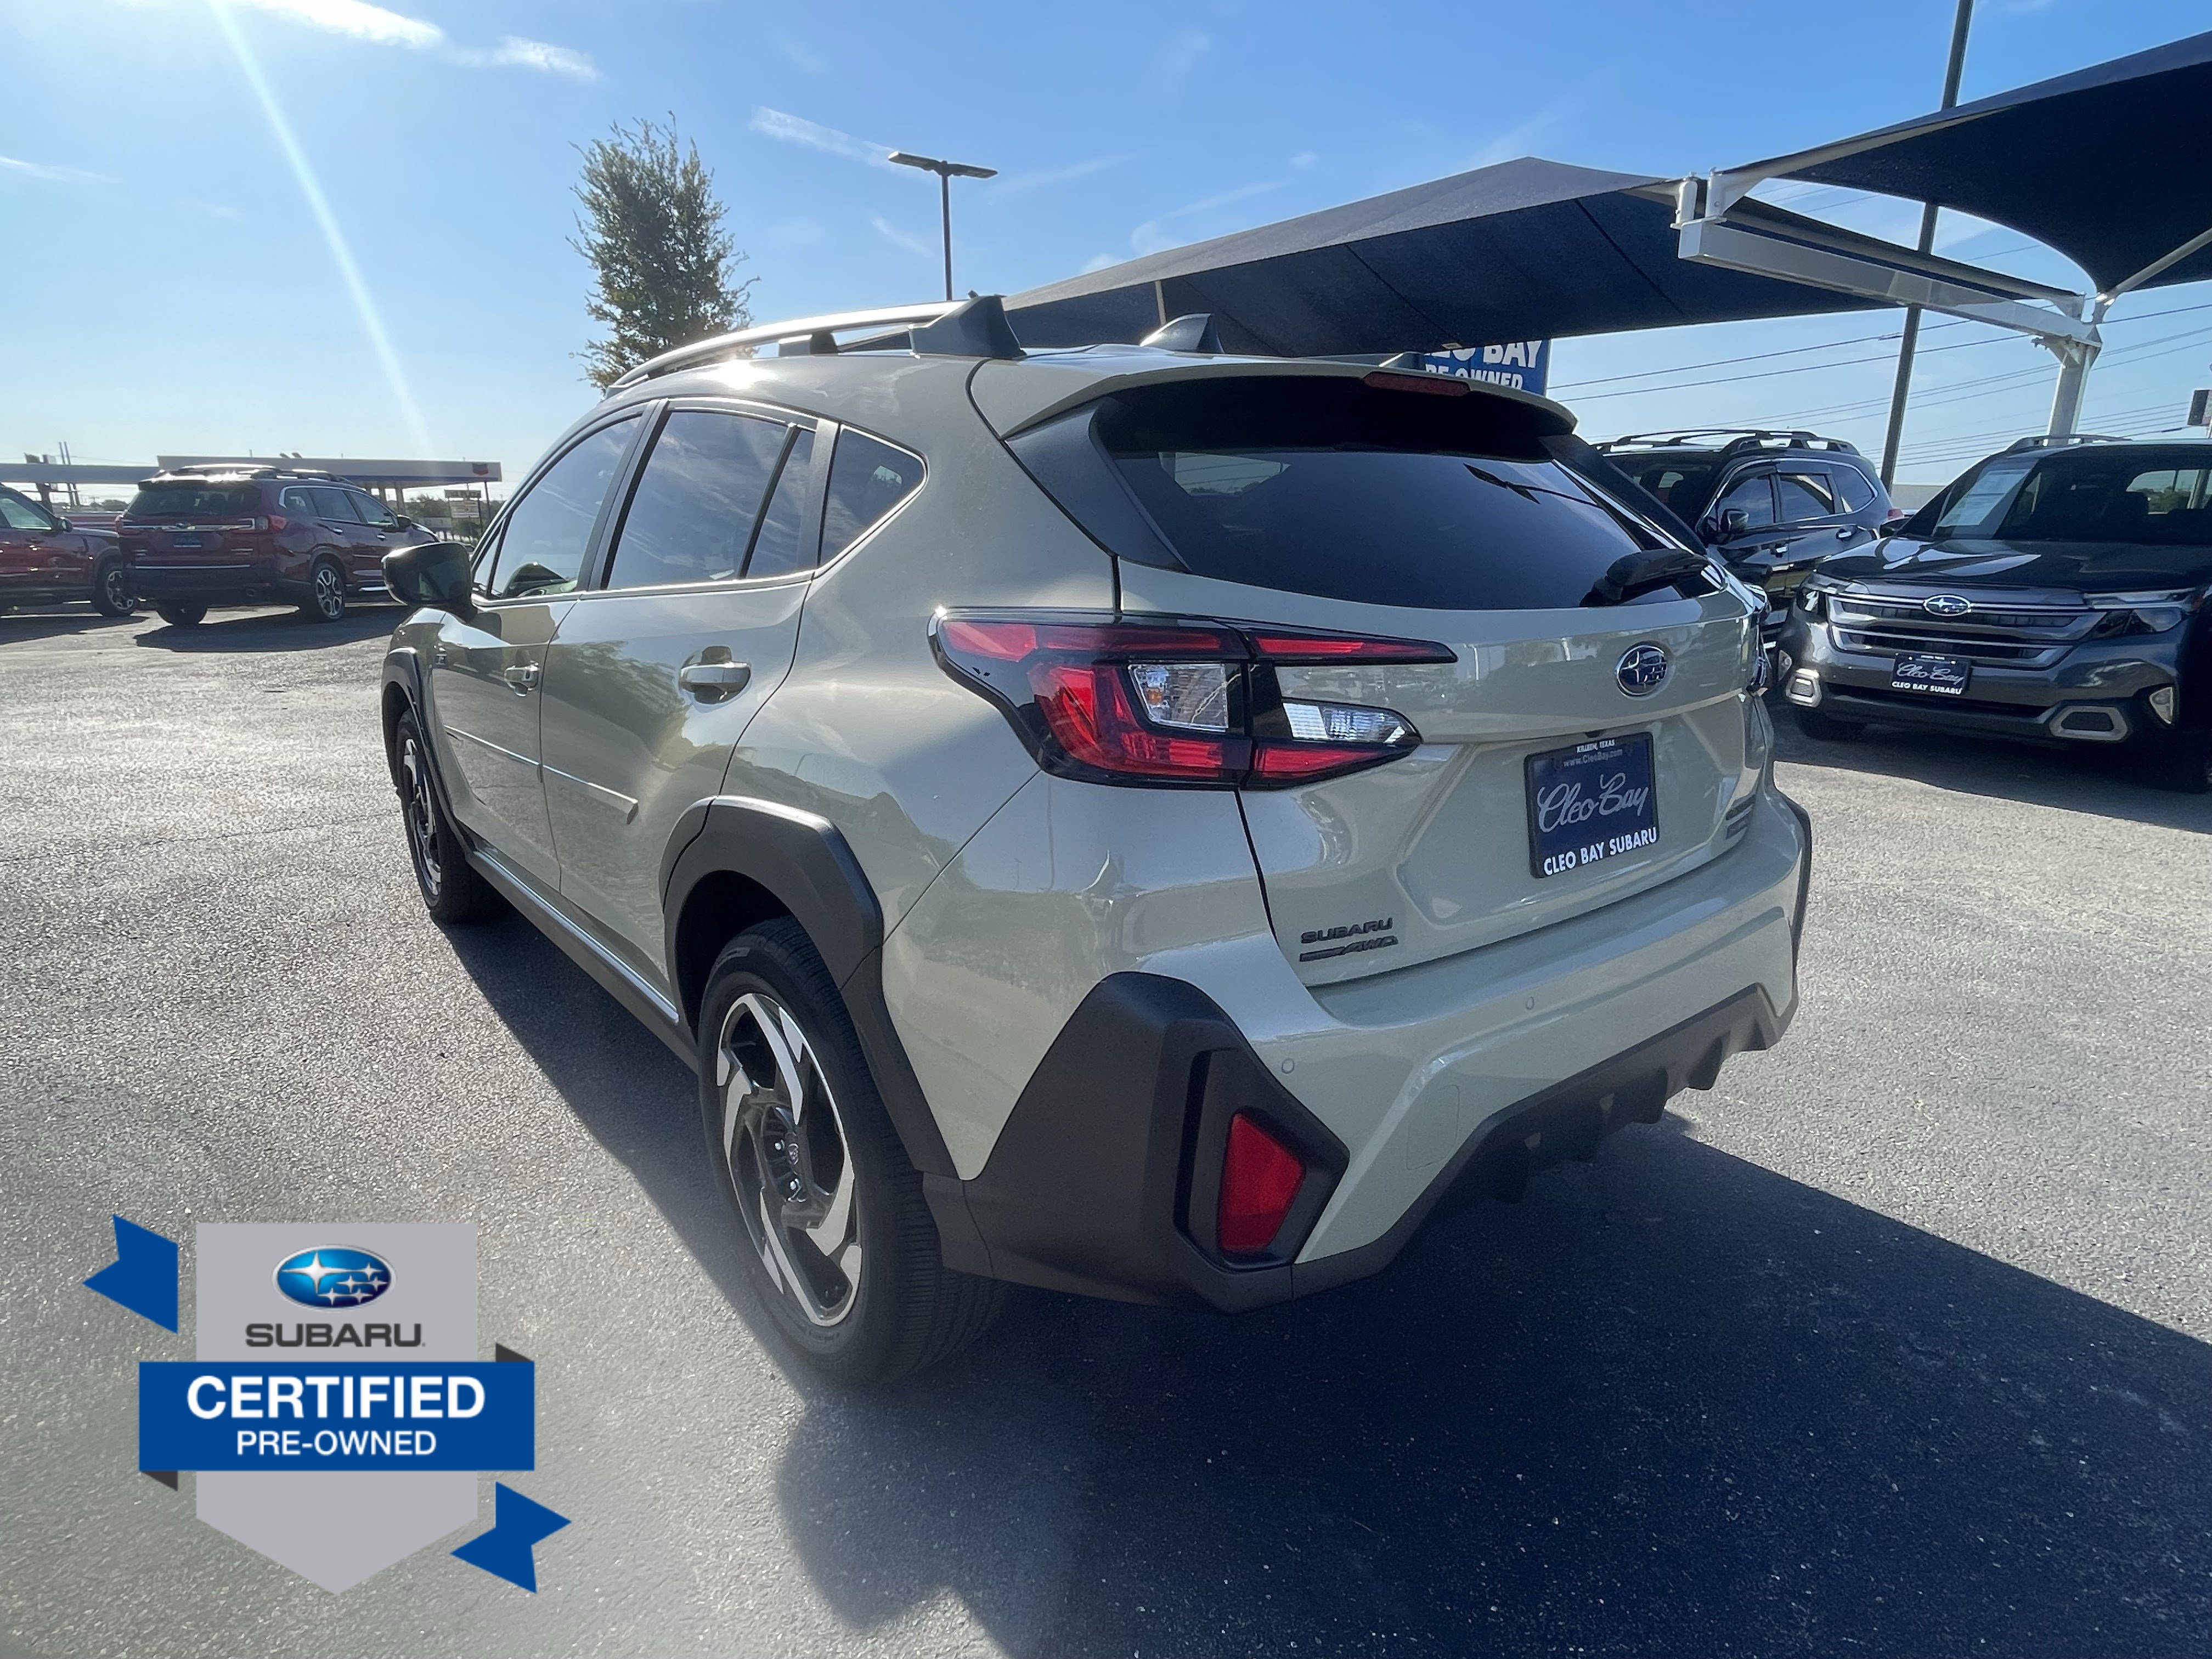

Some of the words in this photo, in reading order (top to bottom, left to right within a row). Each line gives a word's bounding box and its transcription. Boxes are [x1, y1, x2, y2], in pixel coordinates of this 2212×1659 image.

[1483, 340, 1542, 368] BAY
[1930, 685, 1963, 695] SUBARU
[1537, 783, 1599, 833] Cleo
[1599, 772, 1649, 816] Bay
[1543, 851, 1577, 876] CLEO
[1580, 842, 1605, 865] BAY
[1609, 827, 1657, 856] SUBARU
[1301, 917, 1393, 944] SUBARU
